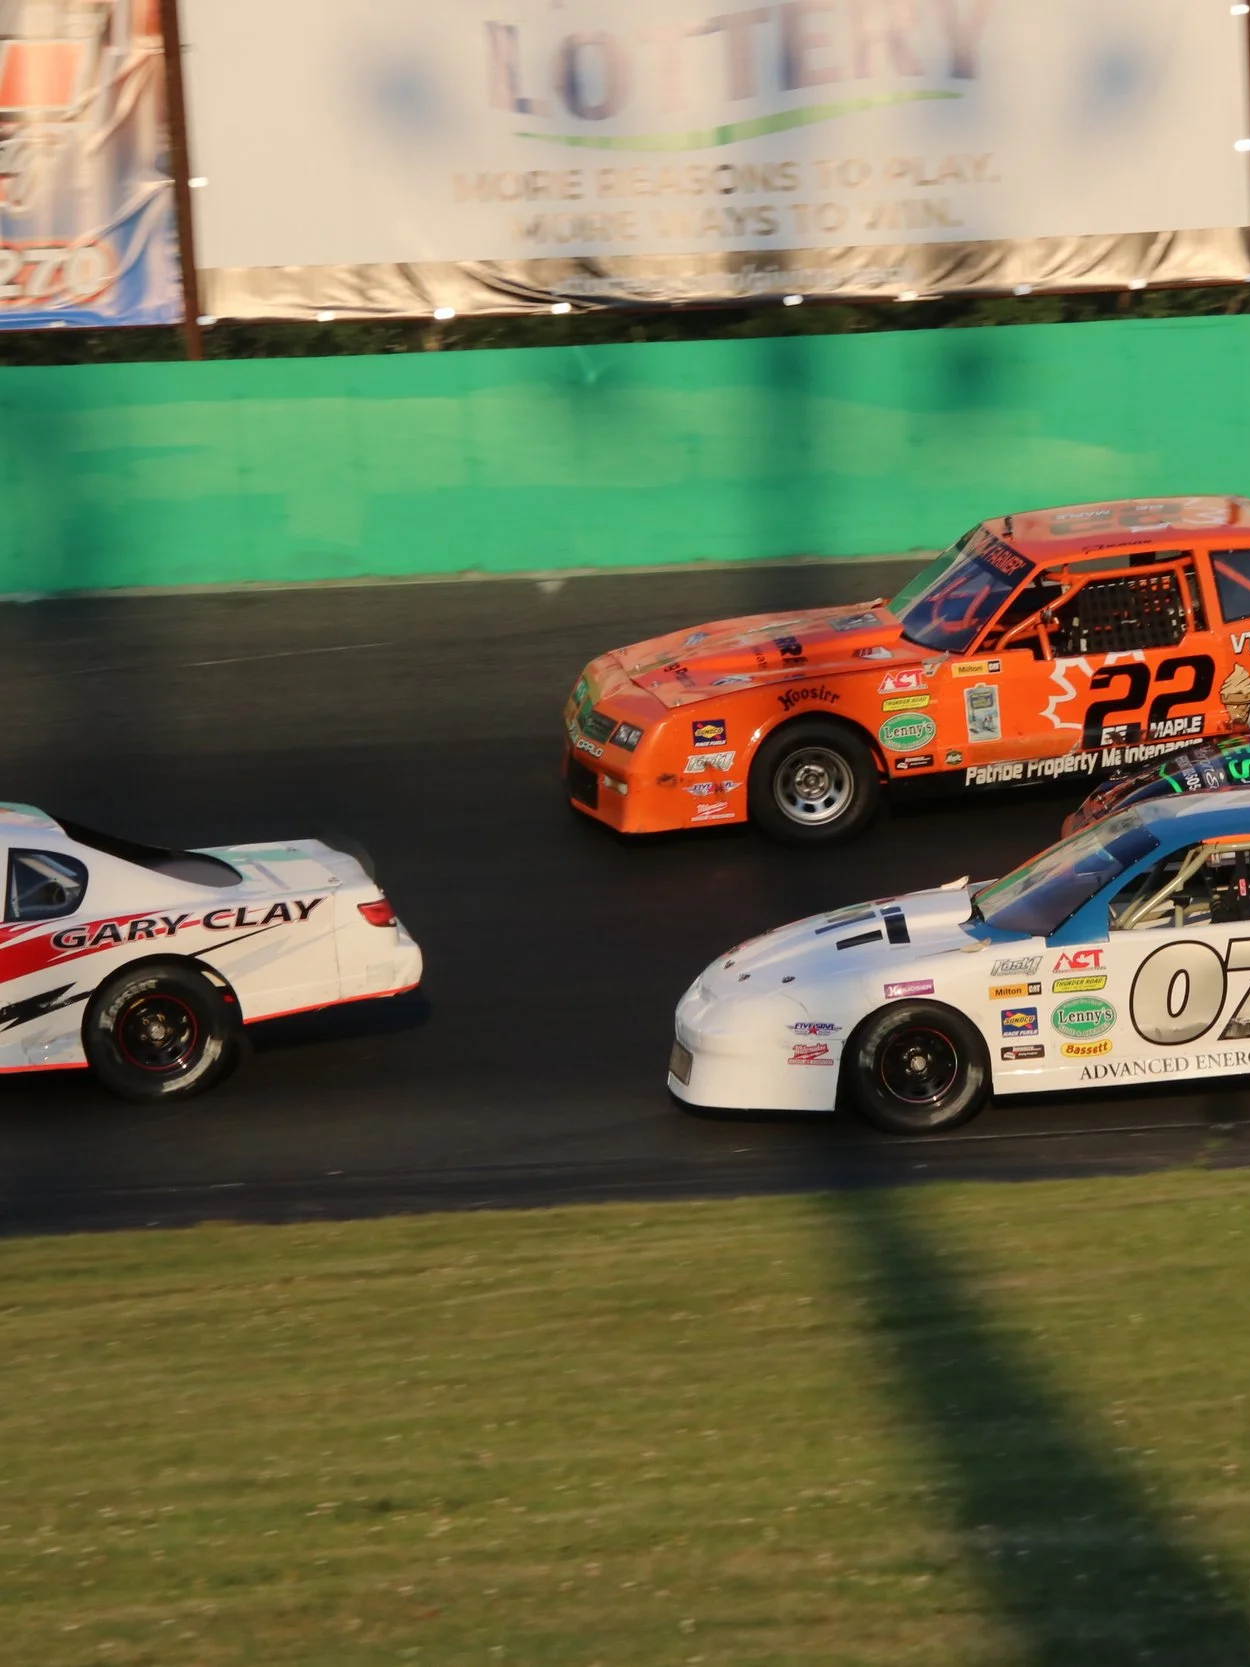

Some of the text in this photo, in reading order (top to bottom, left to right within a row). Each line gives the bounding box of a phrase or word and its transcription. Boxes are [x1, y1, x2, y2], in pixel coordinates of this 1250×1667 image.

[484, 0, 990, 119] LOTTERY
[451, 168, 583, 203] MORE
[595, 160, 802, 199] REASONS
[813, 159, 873, 191] TO
[506, 211, 637, 245] MORE
[649, 205, 780, 240] WAYS
[789, 203, 848, 233] TO
[1081, 654, 1216, 749] 22
[884, 722, 933, 740] Lenny's
[1027, 752, 1098, 779] Property
[1101, 738, 1204, 767] Maintenan
[51, 896, 328, 950] GARY CLAY
[1052, 949, 1104, 973] ACT
[995, 984, 1041, 996] Milton CAT
[1055, 977, 1103, 987] THUNDER ROAD
[1004, 1015, 1036, 1024] SUNOCO
[1059, 1008, 1112, 1025] Lenny's
[1065, 1041, 1108, 1055] Bassett
[1080, 1056, 1190, 1081] ADVANCED
